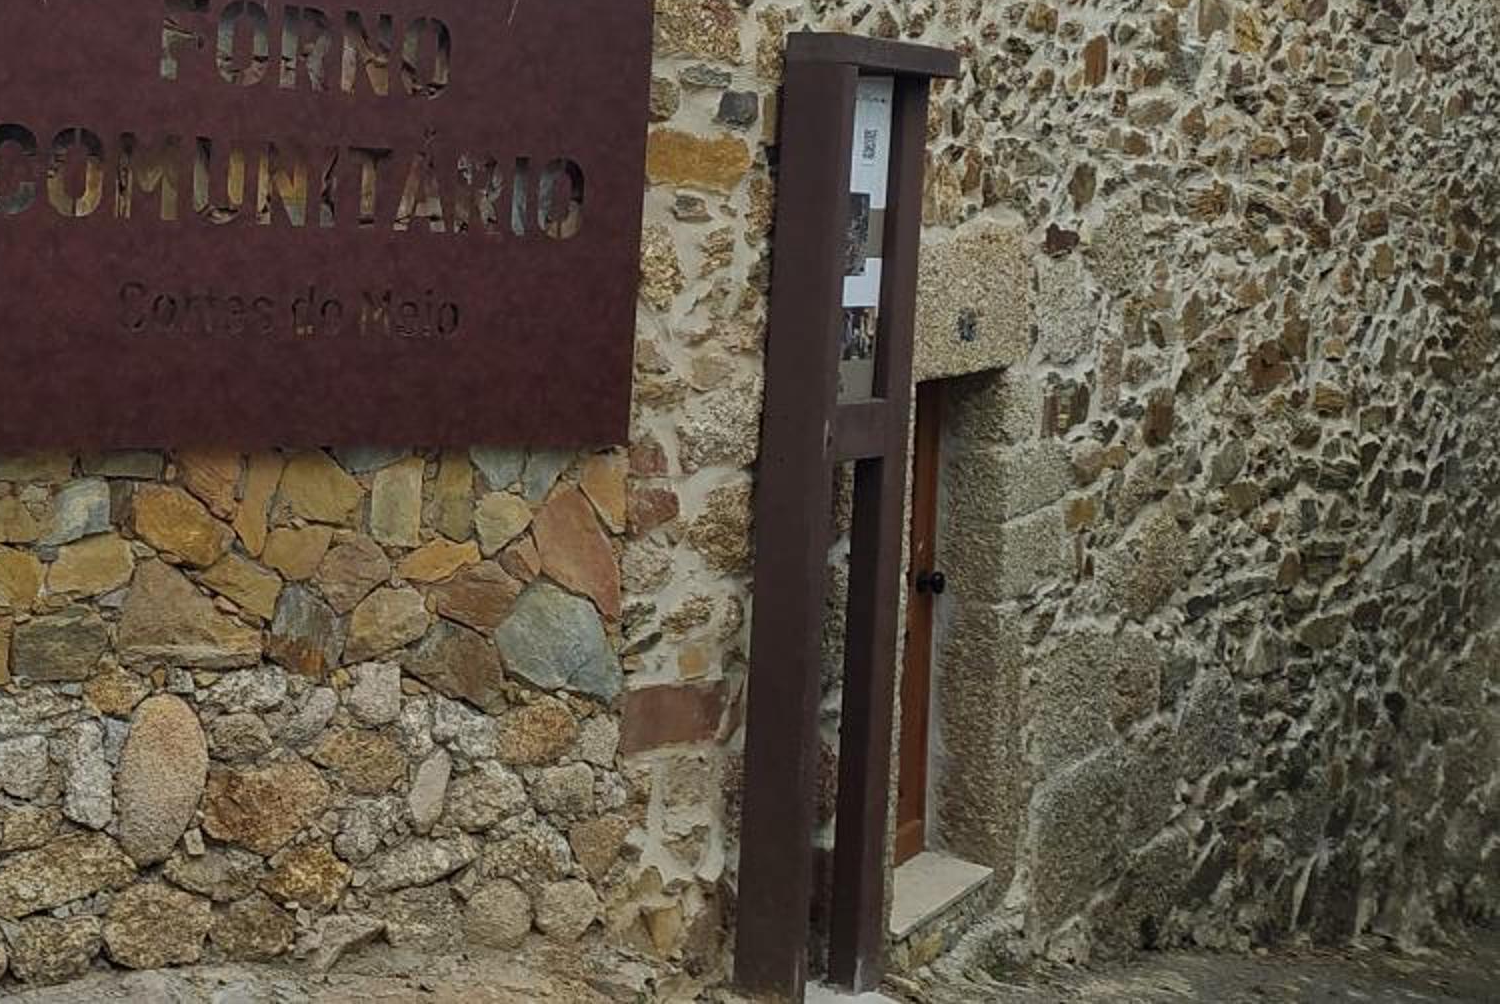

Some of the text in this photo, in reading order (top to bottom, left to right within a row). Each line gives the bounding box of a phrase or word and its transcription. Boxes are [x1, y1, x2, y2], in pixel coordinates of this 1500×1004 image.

[117, 280, 461, 339] Cortes do Meio
